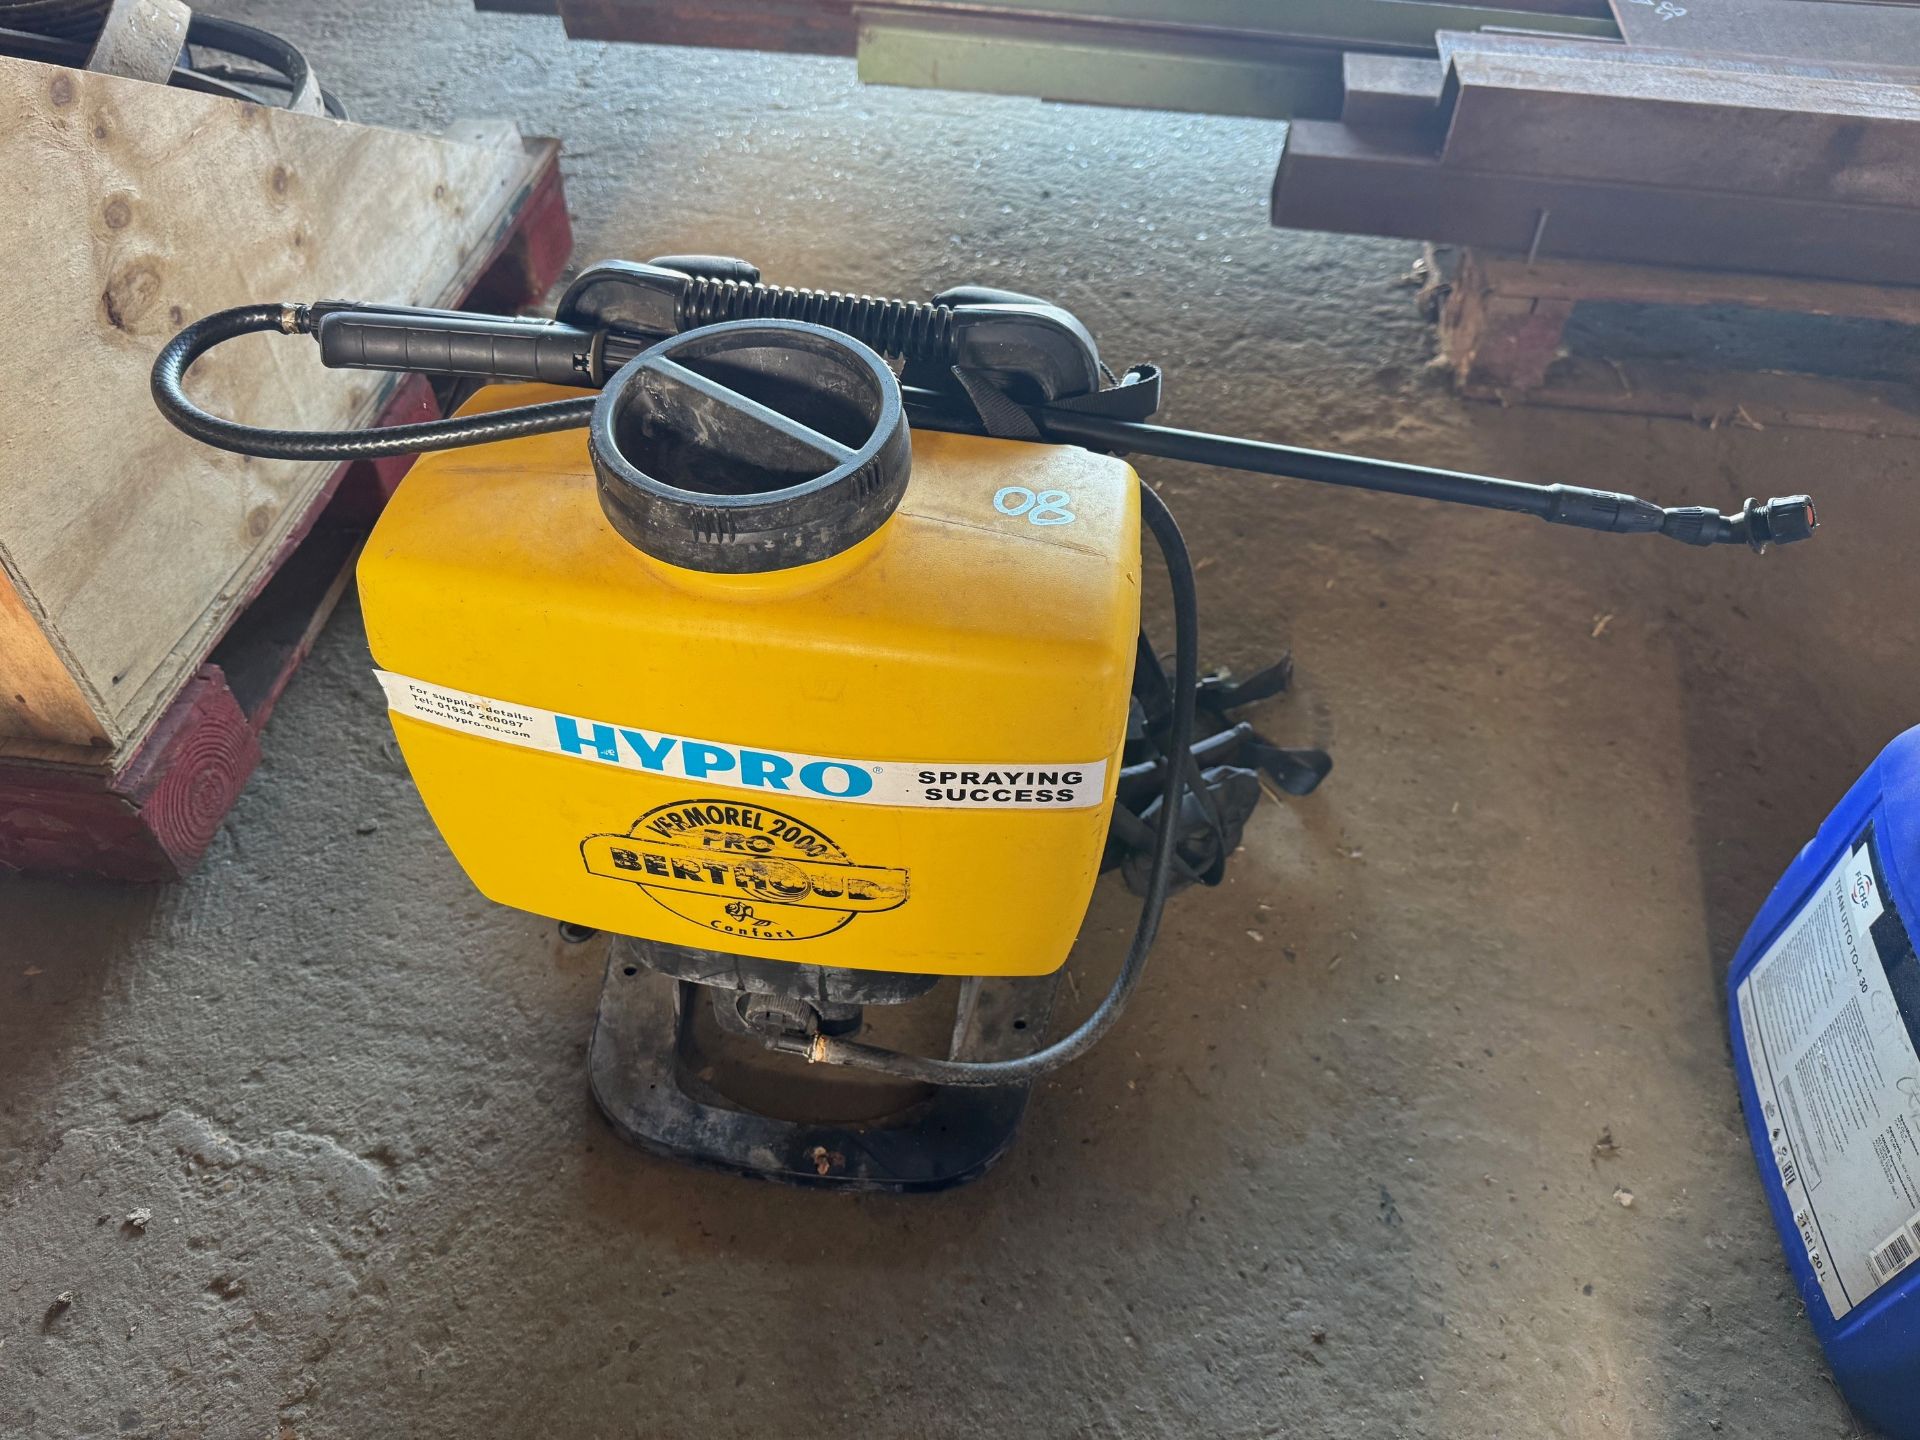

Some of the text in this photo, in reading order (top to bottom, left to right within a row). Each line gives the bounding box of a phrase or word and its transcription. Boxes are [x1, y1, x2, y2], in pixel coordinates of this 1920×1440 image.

[993, 486, 1076, 526] 08
[409, 685, 534, 722] For supplier details:
[412, 694, 523, 728] Tel: 01954 260097
[554, 715, 873, 798] HYPRO
[918, 771, 1083, 785] SPRAYING
[925, 788, 1075, 802] SUCCESS
[645, 805, 828, 858] VERMOREL 2000
[702, 829, 776, 852] PRO
[609, 847, 884, 901] BERTHOUD
[1855, 871, 1869, 909] FUCHS
[710, 920, 797, 938] Confort
[1835, 877, 1845, 912] TITAN
[1841, 912, 1853, 945] UTTO
[1859, 978, 1868, 993] 30
[1804, 1231, 1813, 1245] qt
[1812, 1253, 1823, 1269] 20
[1820, 1272, 1829, 1282] L
